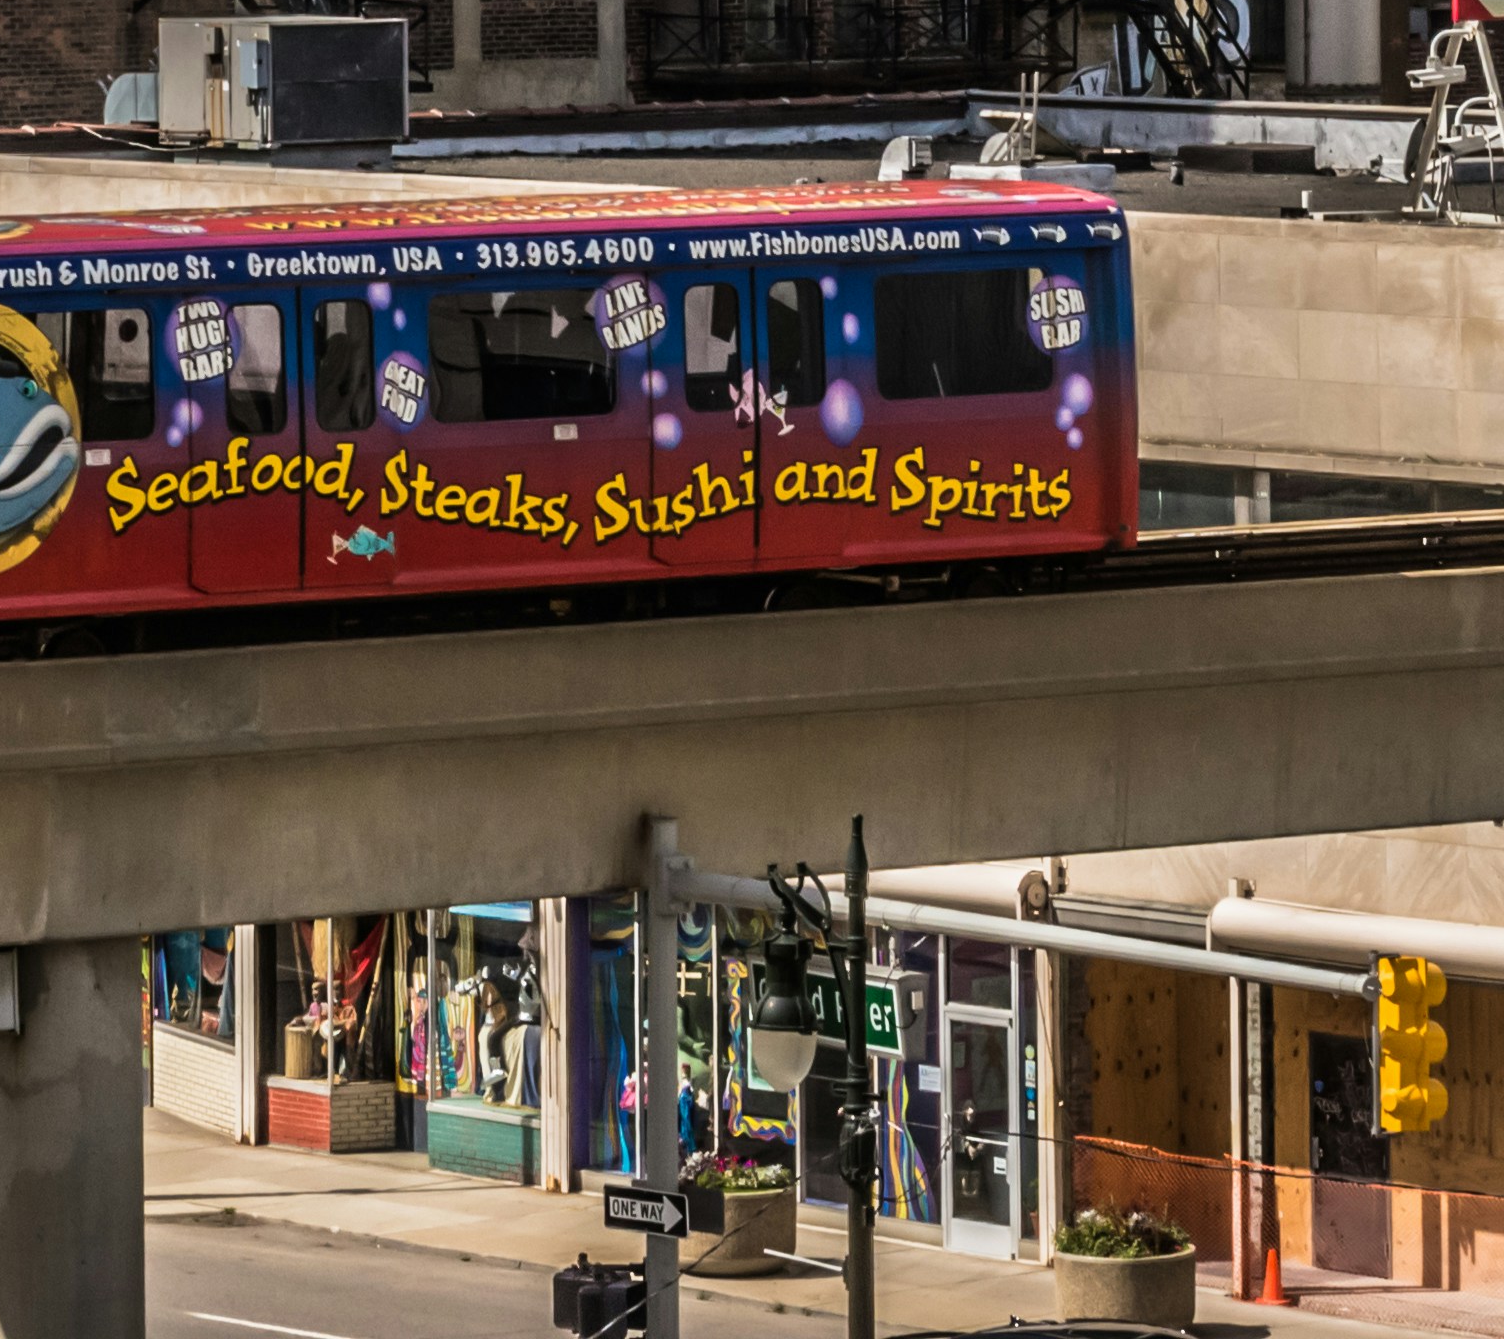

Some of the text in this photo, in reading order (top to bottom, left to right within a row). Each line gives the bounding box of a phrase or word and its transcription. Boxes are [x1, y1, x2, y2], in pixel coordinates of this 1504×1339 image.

[58, 260, 78, 284] &
[82, 258, 179, 285] Monroe
[186, 254, 218, 281] St.
[247, 250, 387, 279] Greektown,
[394, 245, 443, 272] USA
[476, 235, 654, 269] 313.965.4600
[689, 226, 961, 259] www.FishbonesUSA.com
[177, 300, 221, 323] TWO
[604, 281, 648, 318] LIVE
[1029, 288, 1086, 320] SUSHI
[602, 304, 666, 349] BANDS
[1041, 319, 1081, 349] BAR
[105, 437, 1072, 546] Seafood, Steaks, Sushi and Spirits
[612, 1198, 665, 1222] ONE WAY
